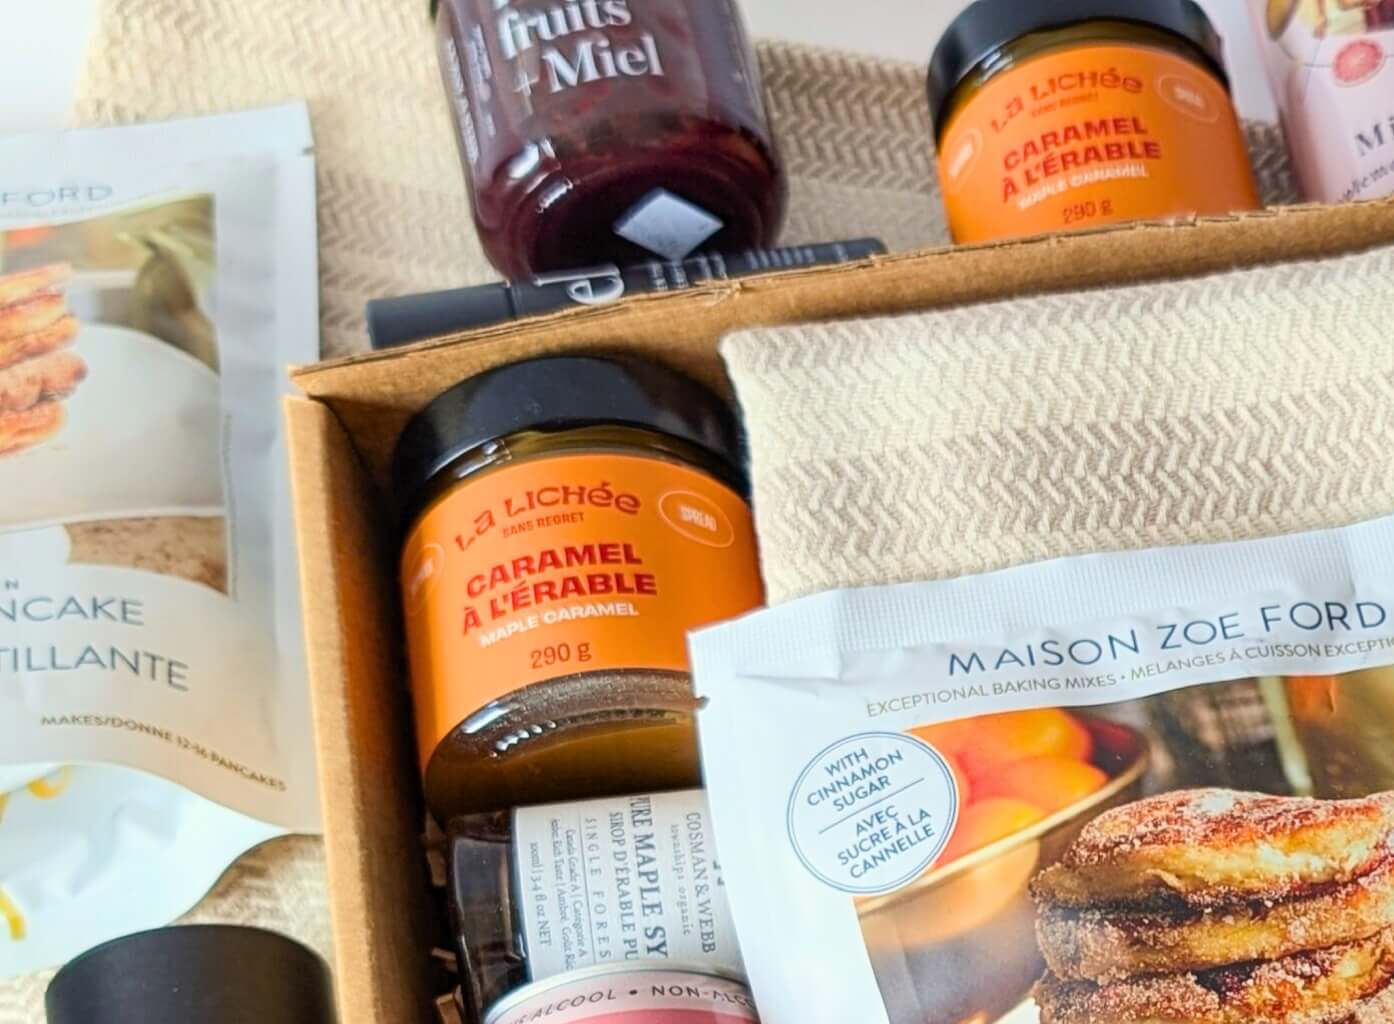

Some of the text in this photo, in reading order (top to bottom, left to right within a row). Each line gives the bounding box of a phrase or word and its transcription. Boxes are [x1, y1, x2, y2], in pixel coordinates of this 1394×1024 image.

[542, 32, 664, 93] Miel
[1003, 116, 1148, 171] CARAMEL
[1001, 140, 1161, 203] À L'ÉRABLE
[467, 543, 643, 598] CARAMEL
[463, 572, 657, 635] À L'ÉRABLE
[480, 601, 640, 648] MAPLE CARAMEL
[531, 644, 571, 669] 290
[949, 601, 1387, 677] MAISON ZOE FORD
[867, 684, 989, 718] EXCEPTIONAL
[992, 678, 1061, 696] BAKING
[1065, 673, 1117, 689] MIXES
[1244, 643, 1322, 660] CUISSON
[211, 752, 287, 792] PANCAKES
[807, 750, 904, 807] CINNAMON
[824, 747, 869, 777] WITH
[832, 775, 892, 813] SUGAR
[856, 805, 899, 837] AVEC
[585, 818, 602, 876] SINGLE
[609, 811, 625, 844] SIROP
[837, 808, 932, 866] SUCRE LA
[850, 823, 936, 879] CANNELLE
[634, 834, 664, 917] MAPLE
[531, 989, 617, 1024] ALCOOL
